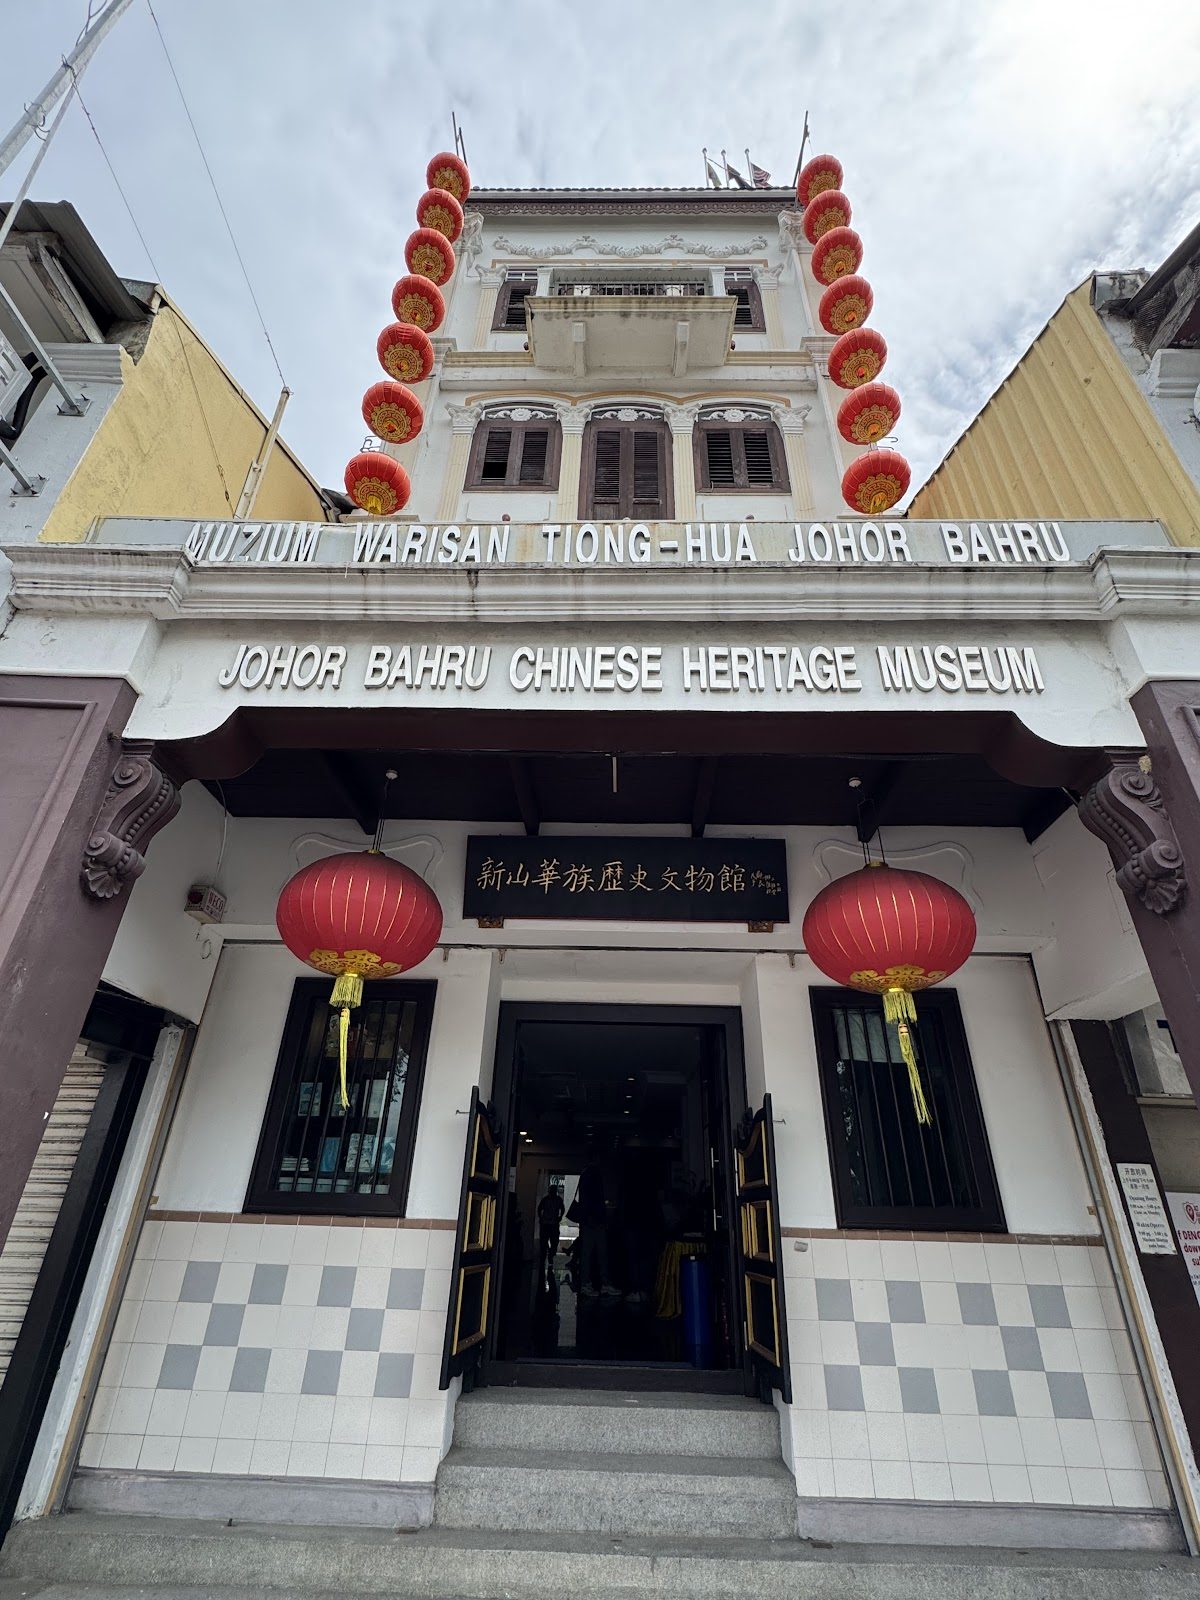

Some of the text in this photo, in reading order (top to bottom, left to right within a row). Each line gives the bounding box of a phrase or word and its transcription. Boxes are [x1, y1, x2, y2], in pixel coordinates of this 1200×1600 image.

[186, 522, 1071, 563] MUZIUM WARISAN TIONG-HUA JOHOR BAHRU
[217, 644, 1046, 693] JOHOR BAHRU CHINESE HERITAGE MUSEUM
